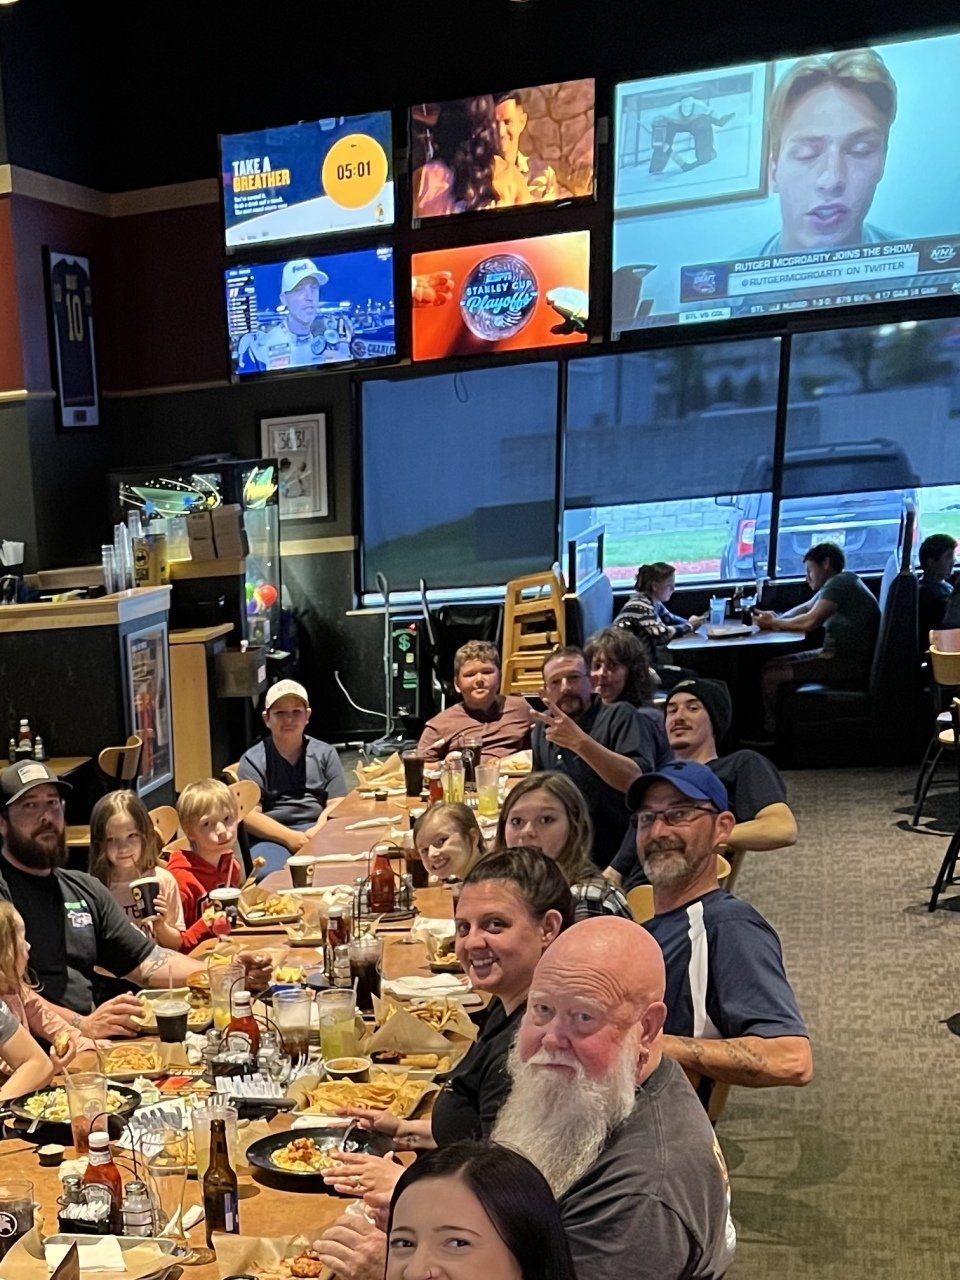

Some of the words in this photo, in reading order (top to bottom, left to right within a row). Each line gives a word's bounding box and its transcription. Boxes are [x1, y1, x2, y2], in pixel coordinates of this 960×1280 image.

[232, 158, 260, 176] TAKE
[262, 156, 271, 172] A
[337, 160, 371, 180] 05:01
[233, 169, 290, 192] BREATHER
[735, 260, 771, 273] RUTGER
[772, 252, 830, 267] MCGROARTY
[832, 249, 860, 261] JOINS
[863, 247, 881, 257] THE
[883, 244, 913, 255] SHOW
[930, 247, 957, 261] NHL
[846, 266, 861, 276] ON
[864, 261, 905, 274] TWITTER
[466, 282, 509, 296] STANLEY
[511, 280, 532, 291] CUP
[466, 290, 534, 314] Playoffs
[65, 292, 84, 342] 10
